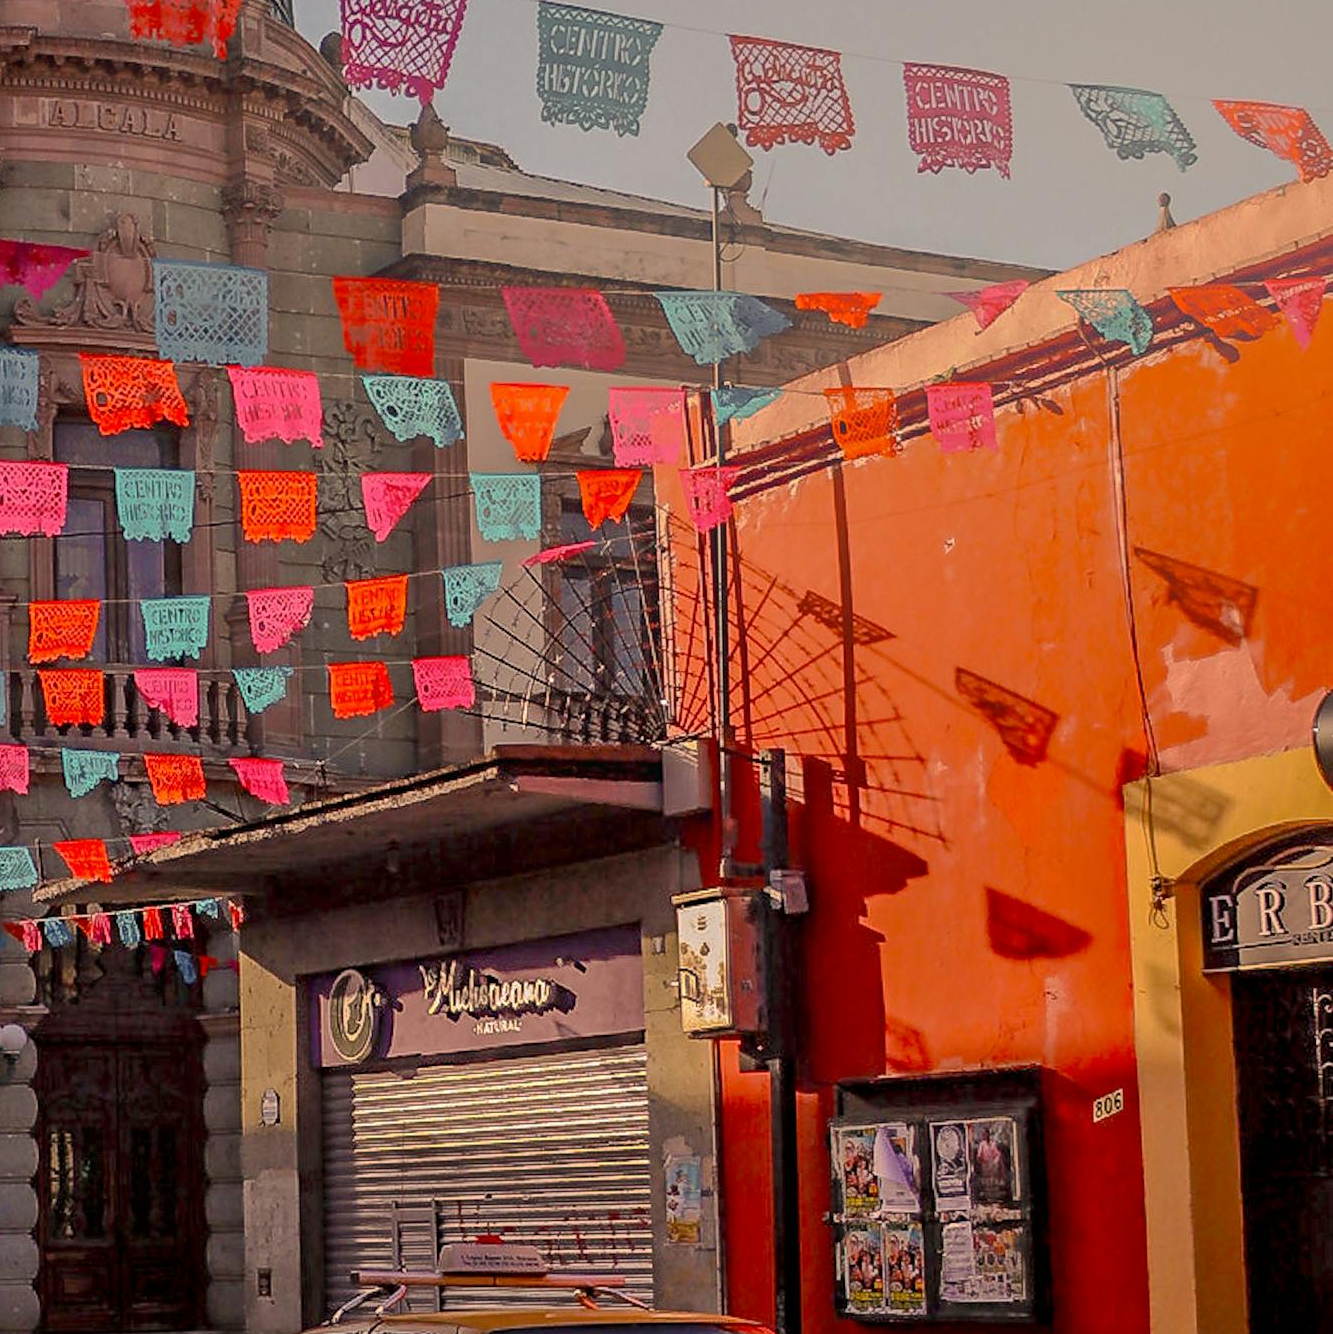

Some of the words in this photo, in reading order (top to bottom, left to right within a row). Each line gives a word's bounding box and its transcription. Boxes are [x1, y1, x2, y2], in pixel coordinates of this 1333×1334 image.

[550, 23, 642, 67] CENTRO
[913, 80, 1000, 117] CENTRO
[48, 98, 184, 143] ALCALA
[124, 480, 184, 500] CENTRO
[152, 609, 201, 626] CENTRO
[1095, 1090, 1124, 1120] 806
